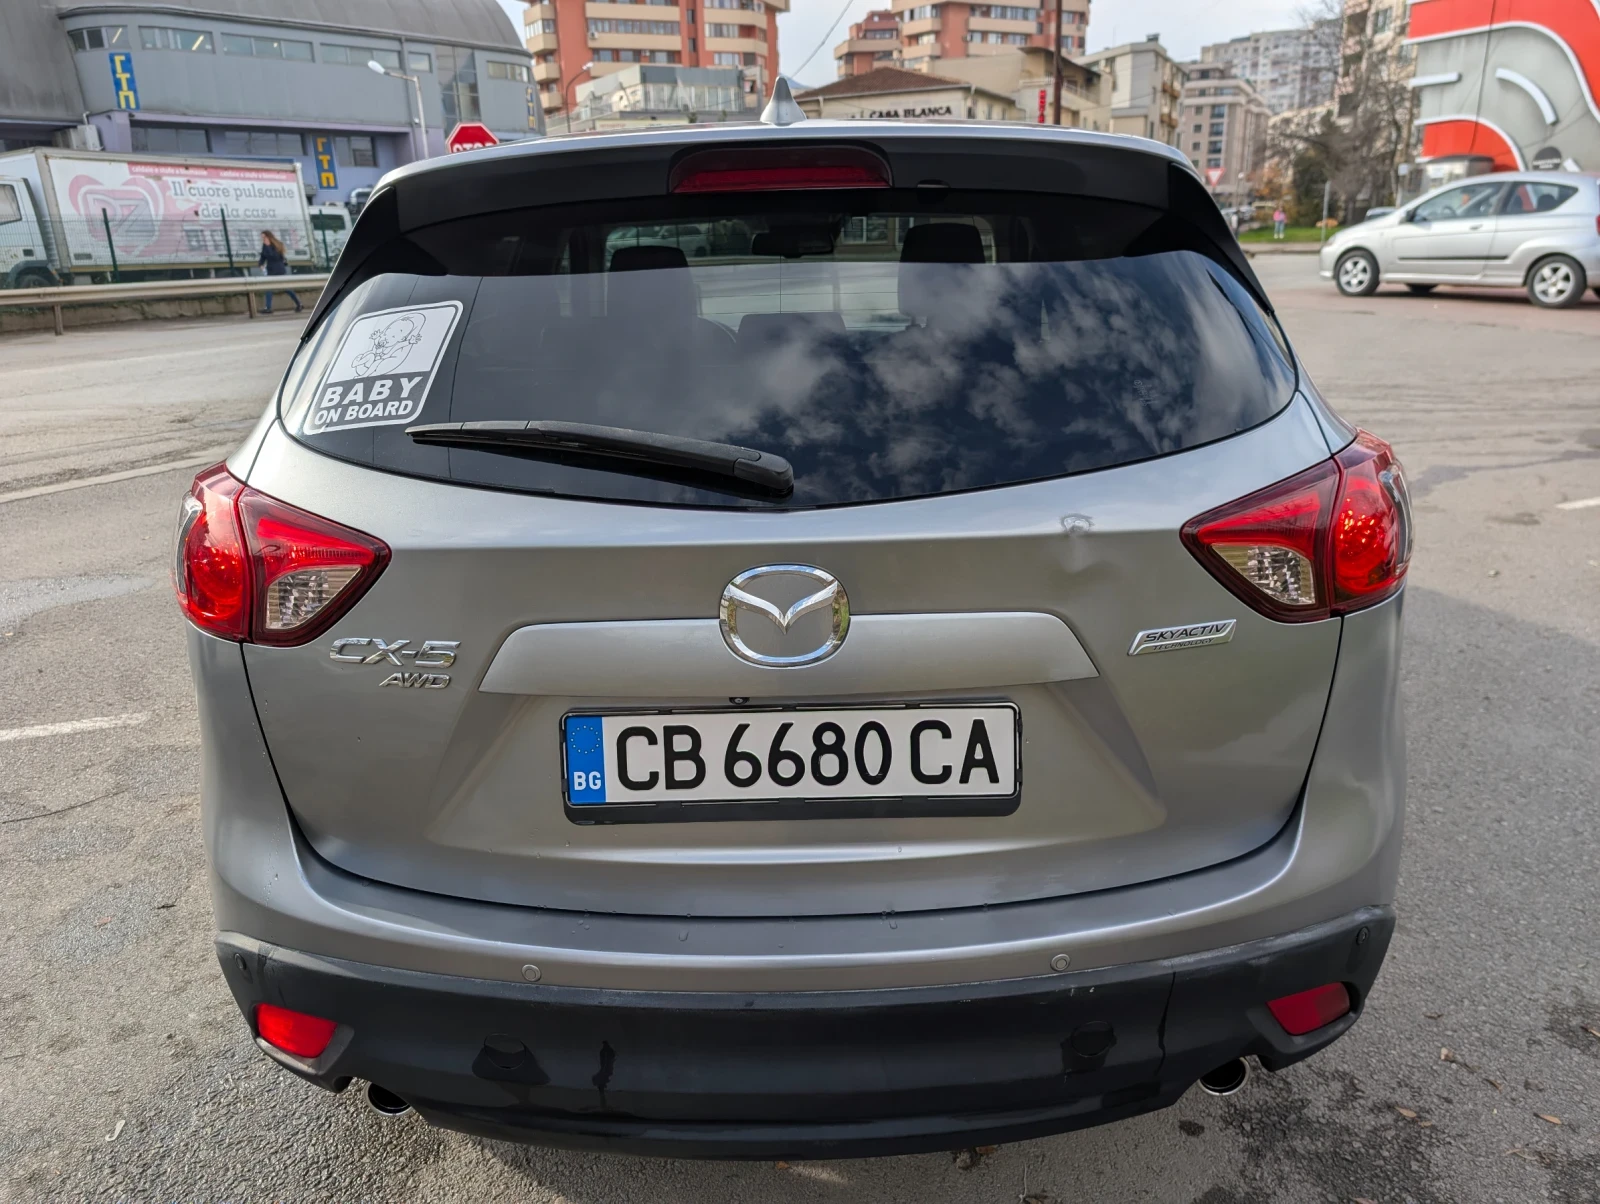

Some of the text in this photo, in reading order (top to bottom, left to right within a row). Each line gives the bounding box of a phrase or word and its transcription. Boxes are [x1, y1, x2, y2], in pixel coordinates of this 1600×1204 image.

[114, 55, 136, 109] ГТП
[903, 106, 952, 118] BLANCA
[316, 137, 336, 188] ГТП
[171, 180, 295, 201] Il cuore pulsante
[202, 203, 277, 219] della casa
[320, 377, 423, 408] BABY
[314, 400, 413, 425] ON BOARD
[1144, 623, 1227, 642] SKYACTIV
[329, 637, 461, 669] CX-5
[1153, 638, 1214, 651] TECHNOLOGY
[379, 671, 451, 689] AWD
[616, 718, 1000, 791] CB 6680 CA
[573, 771, 602, 791] BG
